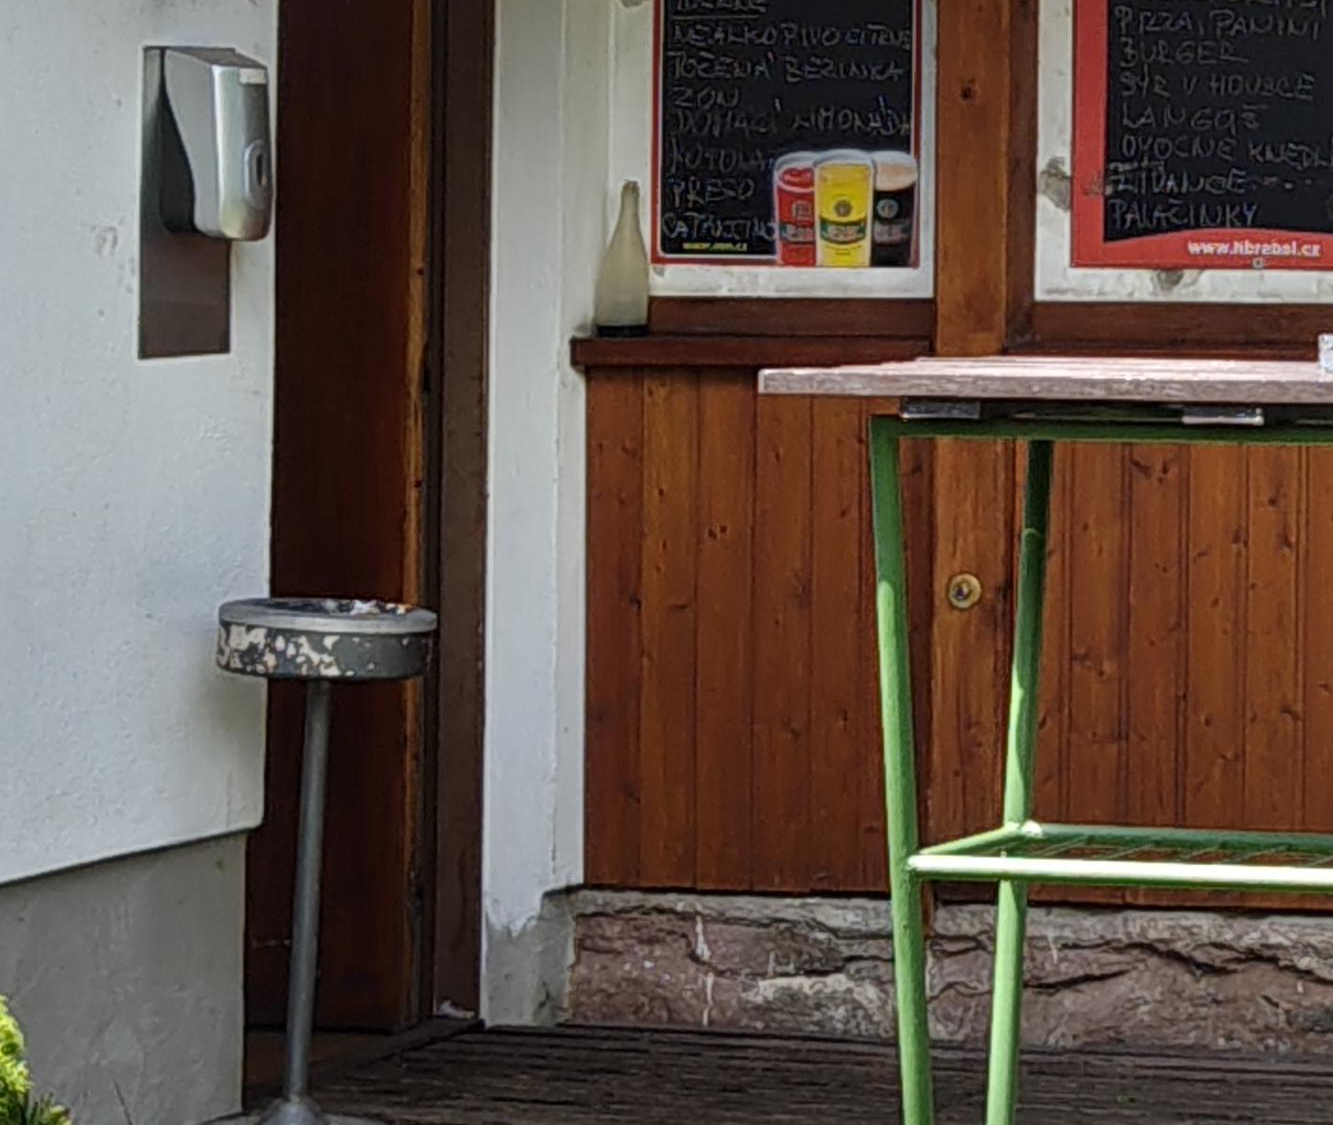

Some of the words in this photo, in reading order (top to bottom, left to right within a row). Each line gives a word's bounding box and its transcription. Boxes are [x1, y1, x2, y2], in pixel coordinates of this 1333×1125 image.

[780, 21, 839, 47] PIVO
[1209, 8, 1320, 40] PANINI
[1118, 37, 1249, 68] BURGER
[673, 85, 740, 110] ZON
[1109, 197, 1260, 229] PALAČINKY
